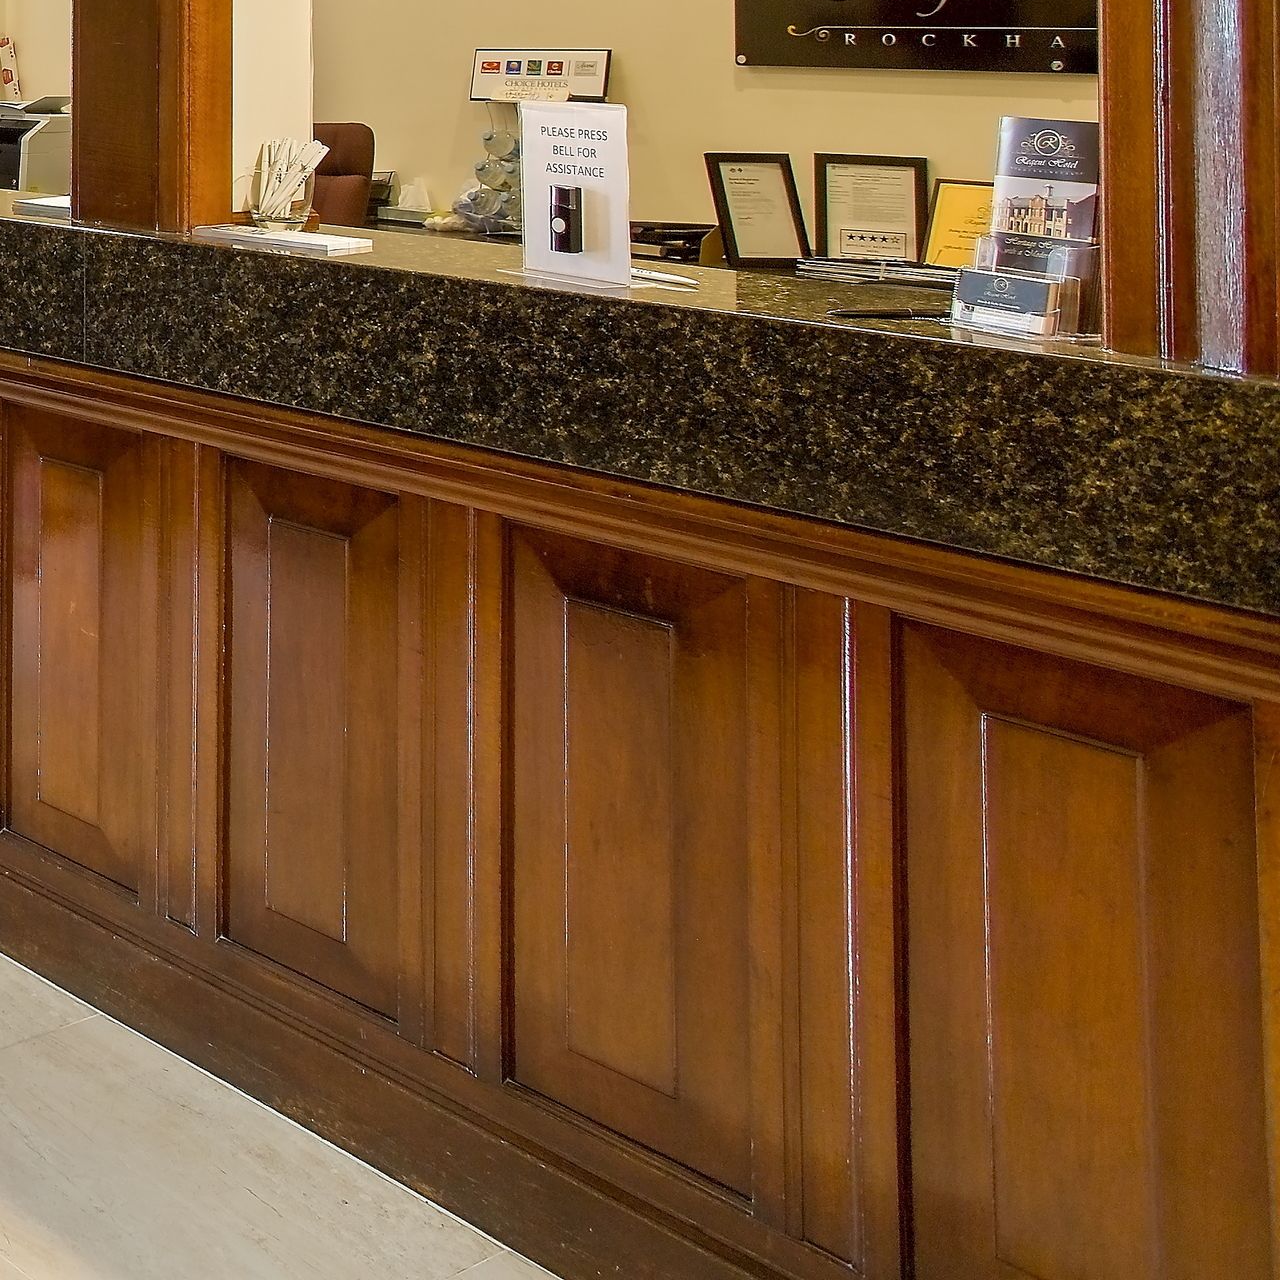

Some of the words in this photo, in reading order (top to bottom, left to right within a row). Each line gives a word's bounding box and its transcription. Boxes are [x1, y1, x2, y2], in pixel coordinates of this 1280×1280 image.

[844, 33, 1065, 48] ROCKHA
[504, 80, 536, 88] CHOICE
[537, 81, 568, 89] HOTELS
[540, 126, 575, 139] PLEASE
[578, 129, 608, 141] PRESS
[552, 145, 575, 157] BELL
[577, 147, 597, 158] FOR
[1015, 156, 1045, 167] Regent
[1048, 158, 1079, 169] Hotel
[545, 162, 605, 178] ASSISTANCE
